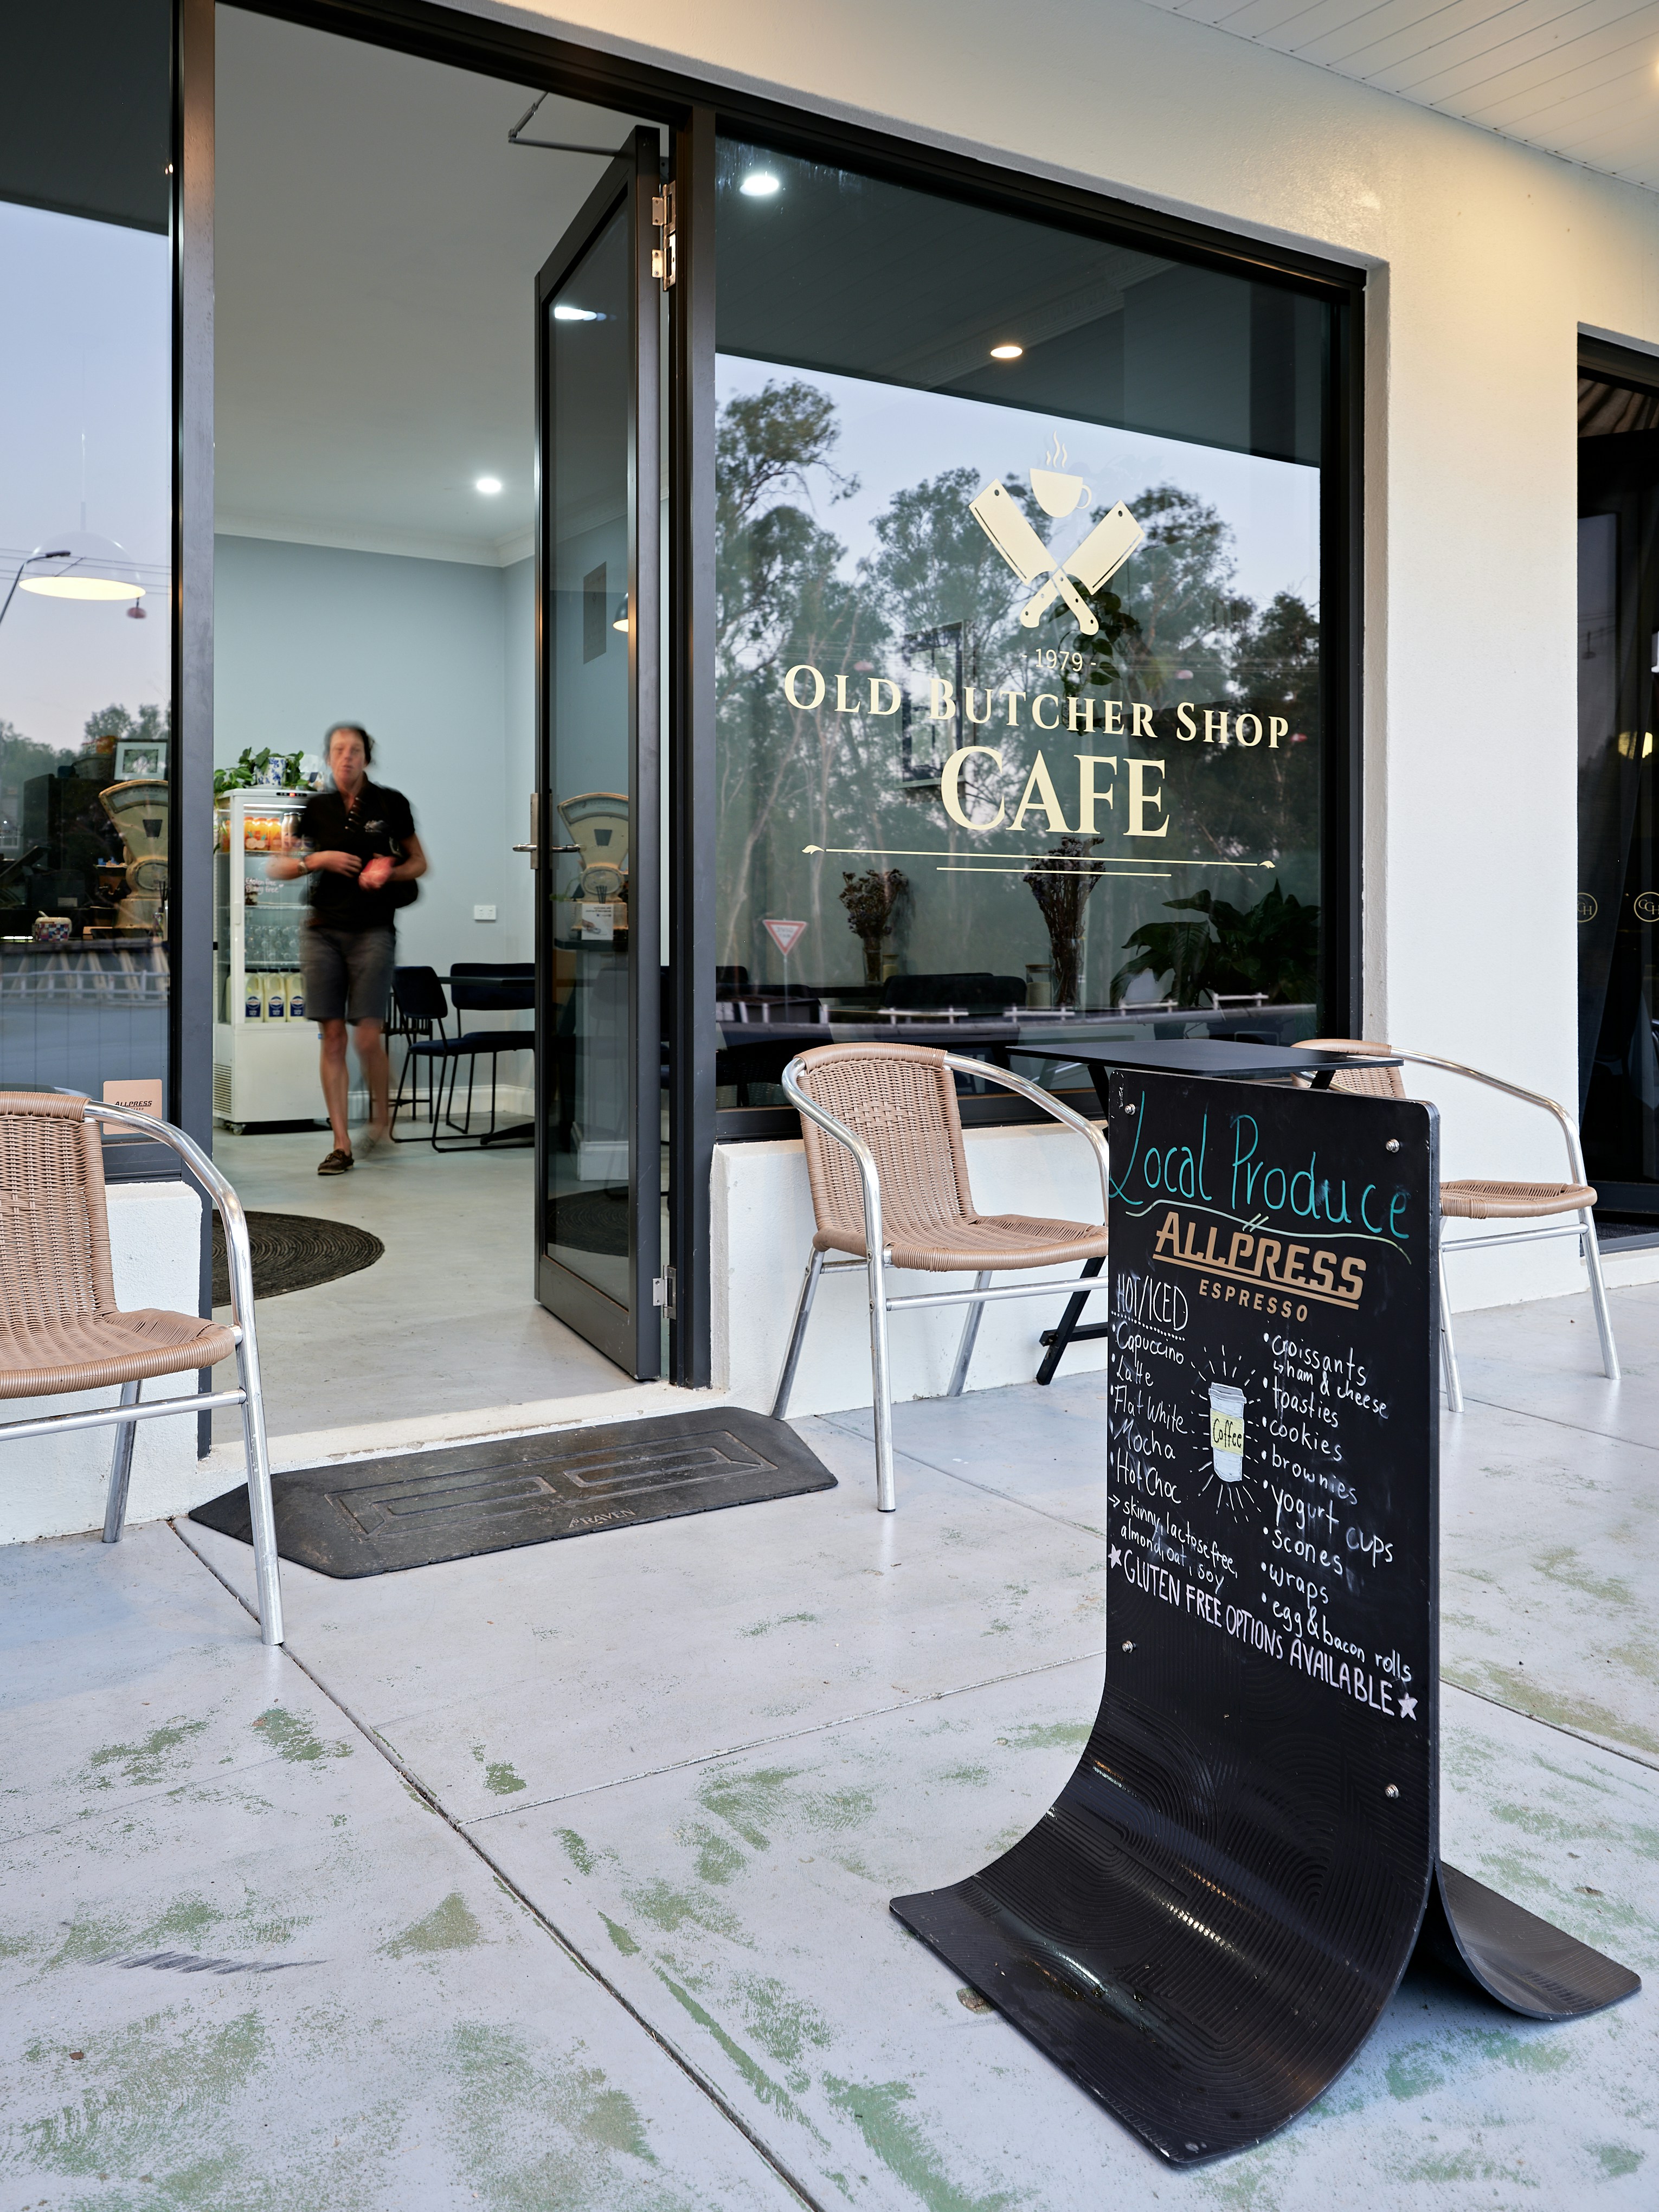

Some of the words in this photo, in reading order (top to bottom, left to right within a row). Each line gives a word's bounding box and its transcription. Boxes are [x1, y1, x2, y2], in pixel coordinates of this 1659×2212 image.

[1035, 648, 1083, 672] 1979
[784, 664, 902, 716] OLD
[927, 678, 1158, 738] BUTCHER
[1175, 702, 1289, 749] SHOP
[941, 745, 1170, 838] CAFE
[1109, 1090, 1212, 1205] Local
[1229, 1114, 1411, 1239] Produce
[1155, 1211, 1367, 1301] ALLPRESS
[1116, 1274, 1189, 1332] HOT/ICED
[1199, 1278, 1308, 1322] ESPRESSO
[1116, 1355, 1154, 1387] Latte
[1287, 1360, 1313, 1385] ham
[1320, 1370, 1330, 1397] &
[1336, 1379, 1390, 1419] cheese
[1114, 1385, 1144, 1417] Flat
[1147, 1396, 1188, 1434] White
[1272, 1375, 1339, 1428] toasties
[1114, 1418, 1176, 1459] Mocha
[1213, 1418, 1243, 1448] Coffee
[1117, 1447, 1142, 1491] Hot
[1146, 1466, 1181, 1504] Choc
[1272, 1443, 1358, 1505] brownies
[1198, 1563, 1224, 1594] soy
[1271, 1529, 1343, 1575] scones
[1269, 1562, 1329, 1609] wraps
[1124, 1549, 1180, 1606] GLUTEN
[1185, 1584, 1222, 1628] FREE
[1225, 1604, 1283, 1660] OPTIONS
[1289, 1638, 1395, 1716] AVAILABLE
[1322, 1613, 1365, 1663] bacon
[1374, 1648, 1412, 1682] rolls
